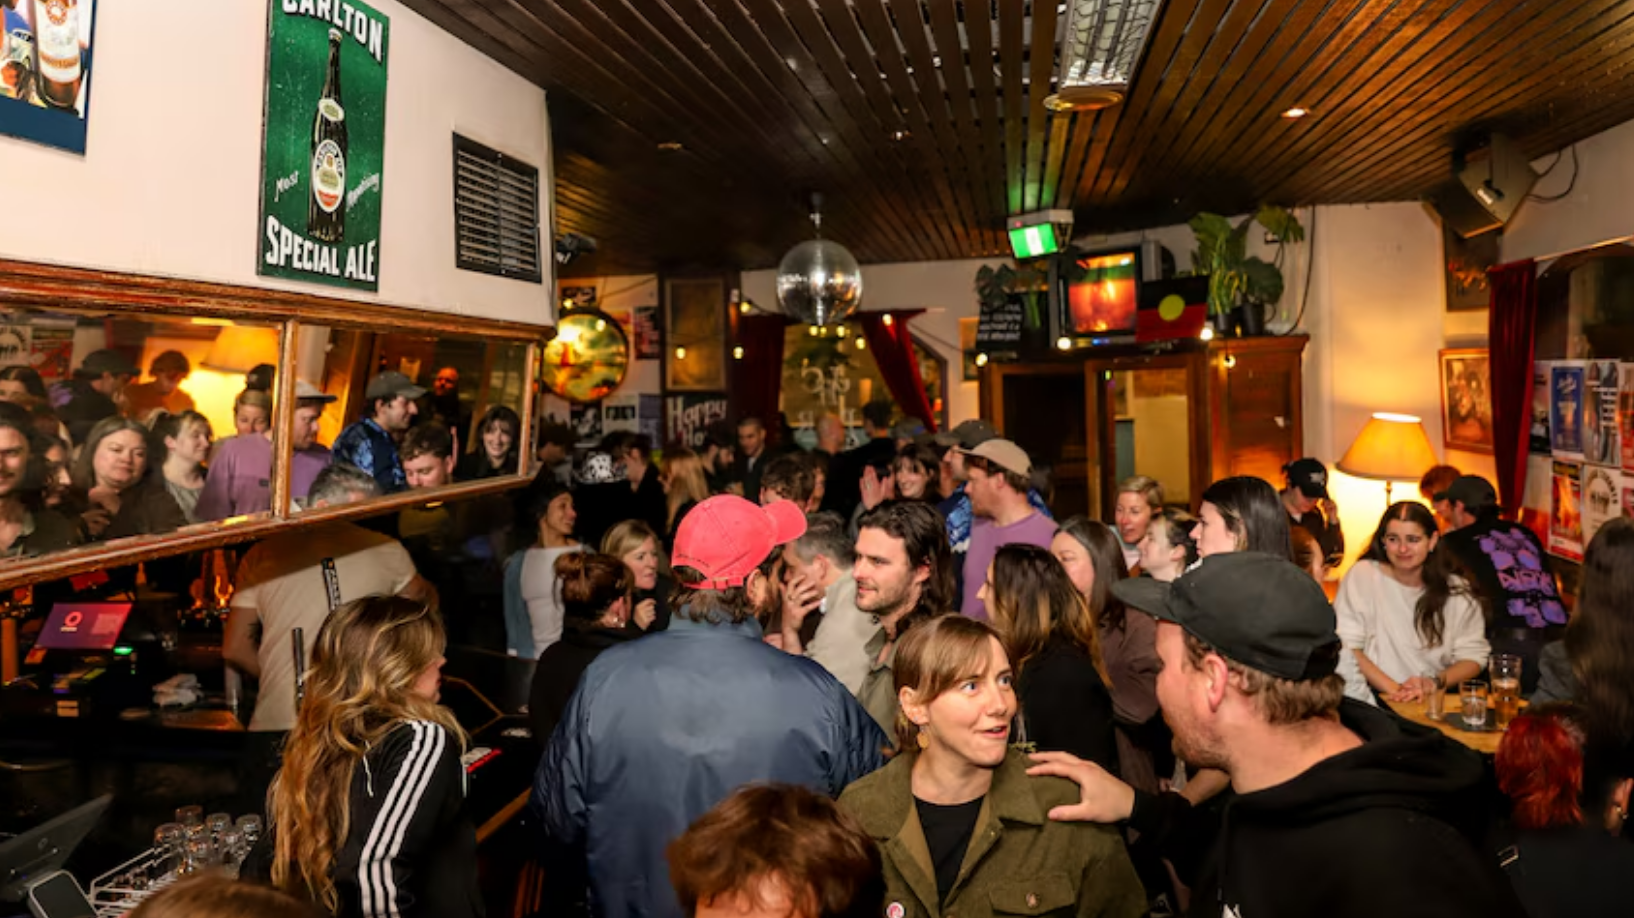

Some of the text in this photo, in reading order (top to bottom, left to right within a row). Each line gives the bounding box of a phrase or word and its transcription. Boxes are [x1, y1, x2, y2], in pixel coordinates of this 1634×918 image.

[265, 214, 377, 283] SPECIAL ALE
[666, 396, 727, 442] Happy
